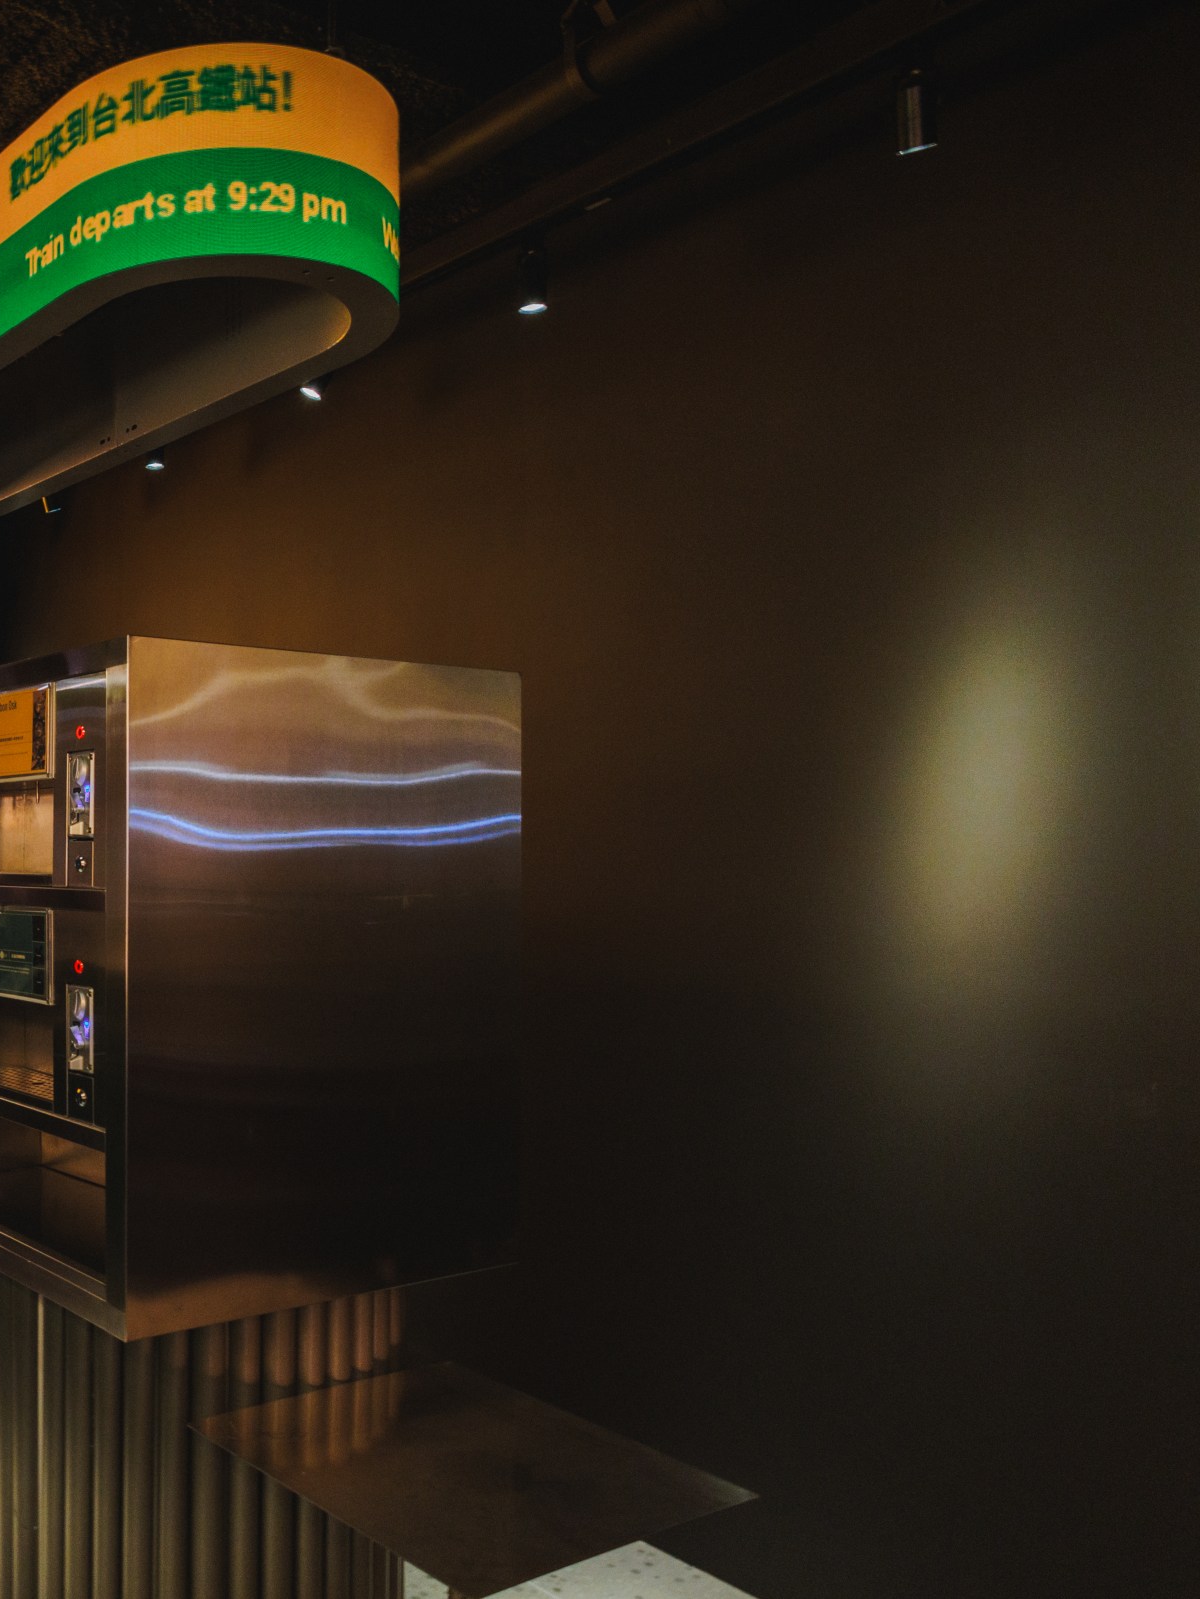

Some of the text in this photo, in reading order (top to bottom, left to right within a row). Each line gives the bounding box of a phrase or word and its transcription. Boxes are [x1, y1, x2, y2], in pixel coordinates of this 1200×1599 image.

[25, 181, 347, 278] Train departs at 9:29 pm
